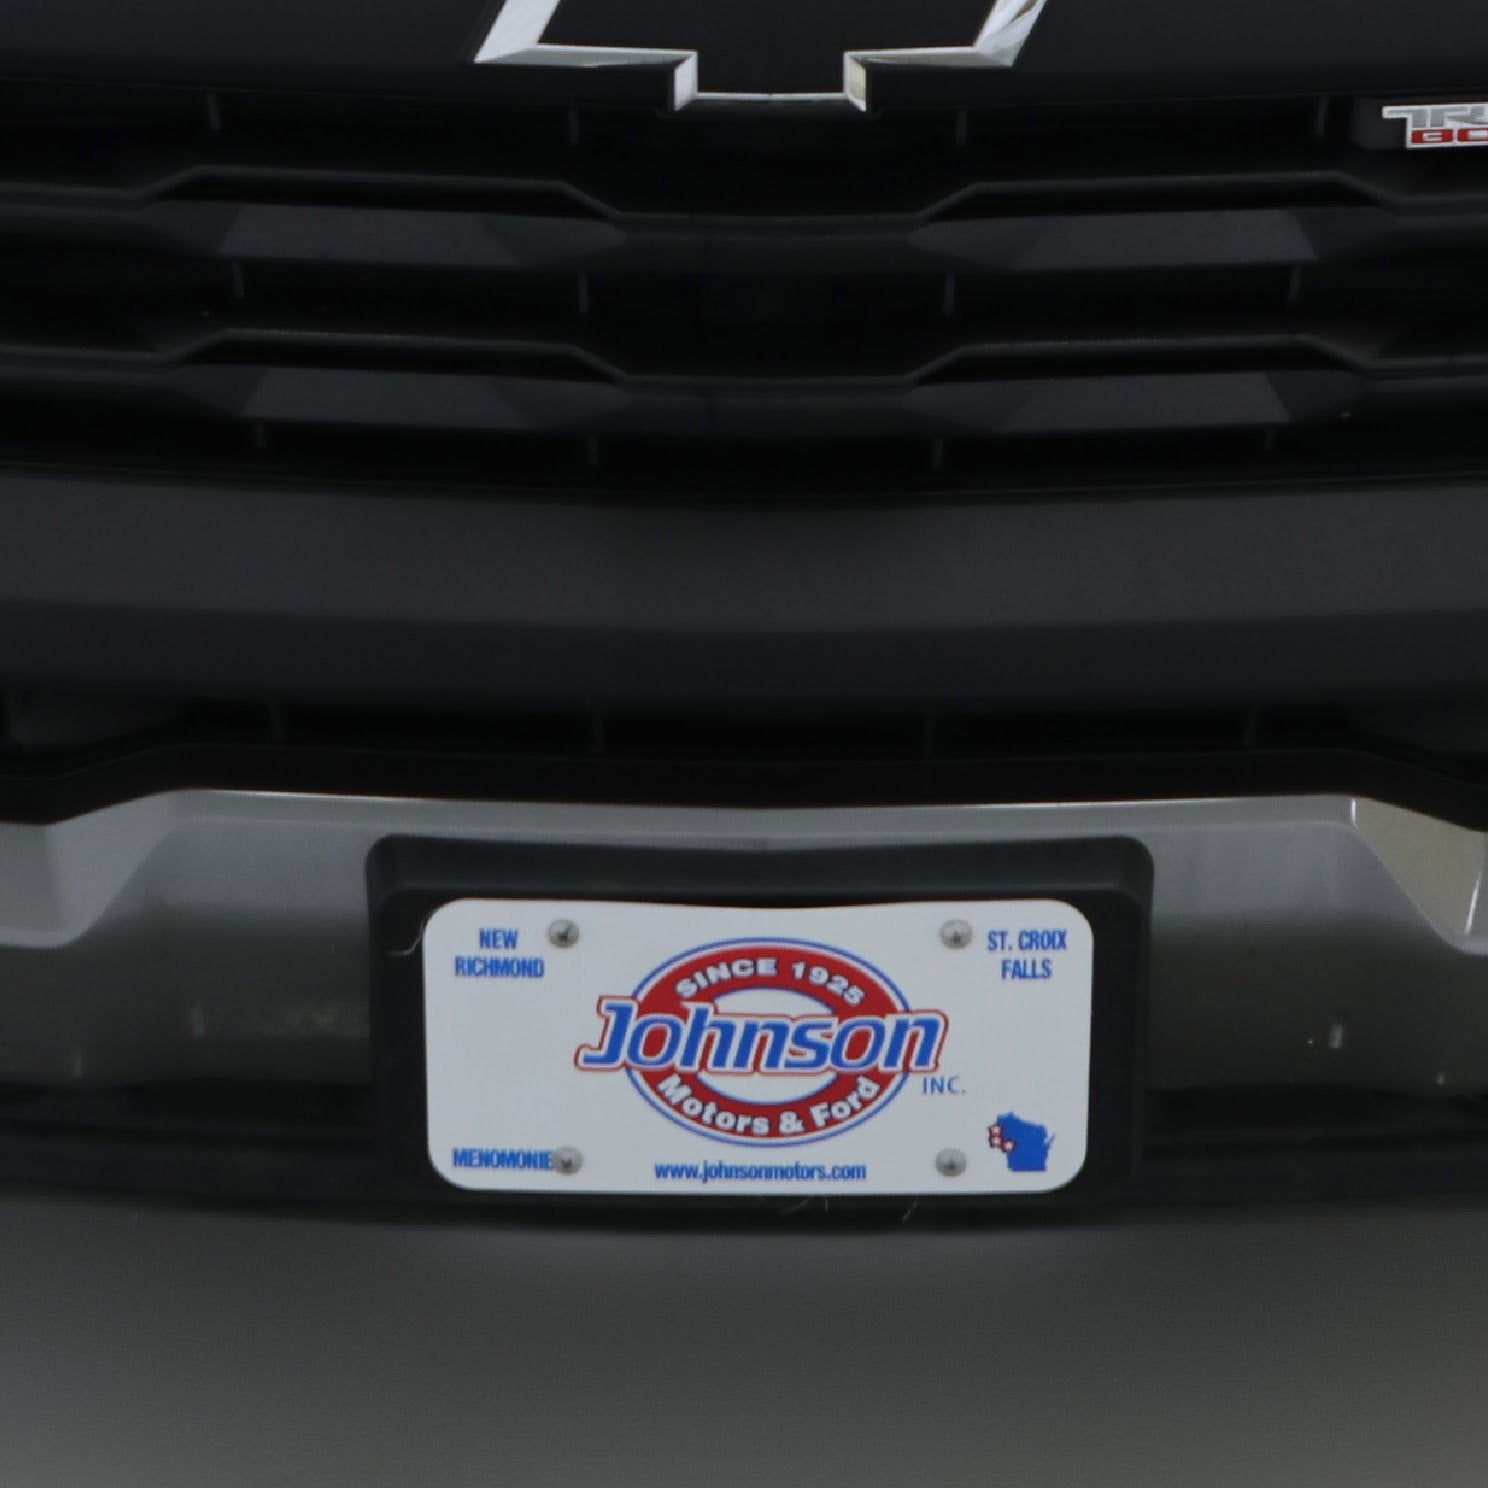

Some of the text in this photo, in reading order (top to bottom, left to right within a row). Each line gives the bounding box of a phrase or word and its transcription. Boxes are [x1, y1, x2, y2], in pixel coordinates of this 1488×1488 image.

[479, 928, 518, 949] NEW
[988, 929, 1067, 951] ST. CROIX
[455, 956, 545, 978] RICHMOND
[1001, 958, 1052, 979] FALLS
[675, 957, 867, 1007] SINCE 1925
[579, 1000, 944, 1071] Johnson
[923, 1076, 966, 1095] INC.
[657, 1073, 881, 1137] Motors & Ford
[453, 1148, 555, 1169] MENOMONIE
[654, 1161, 867, 1184] www.johnsonmotors.com
